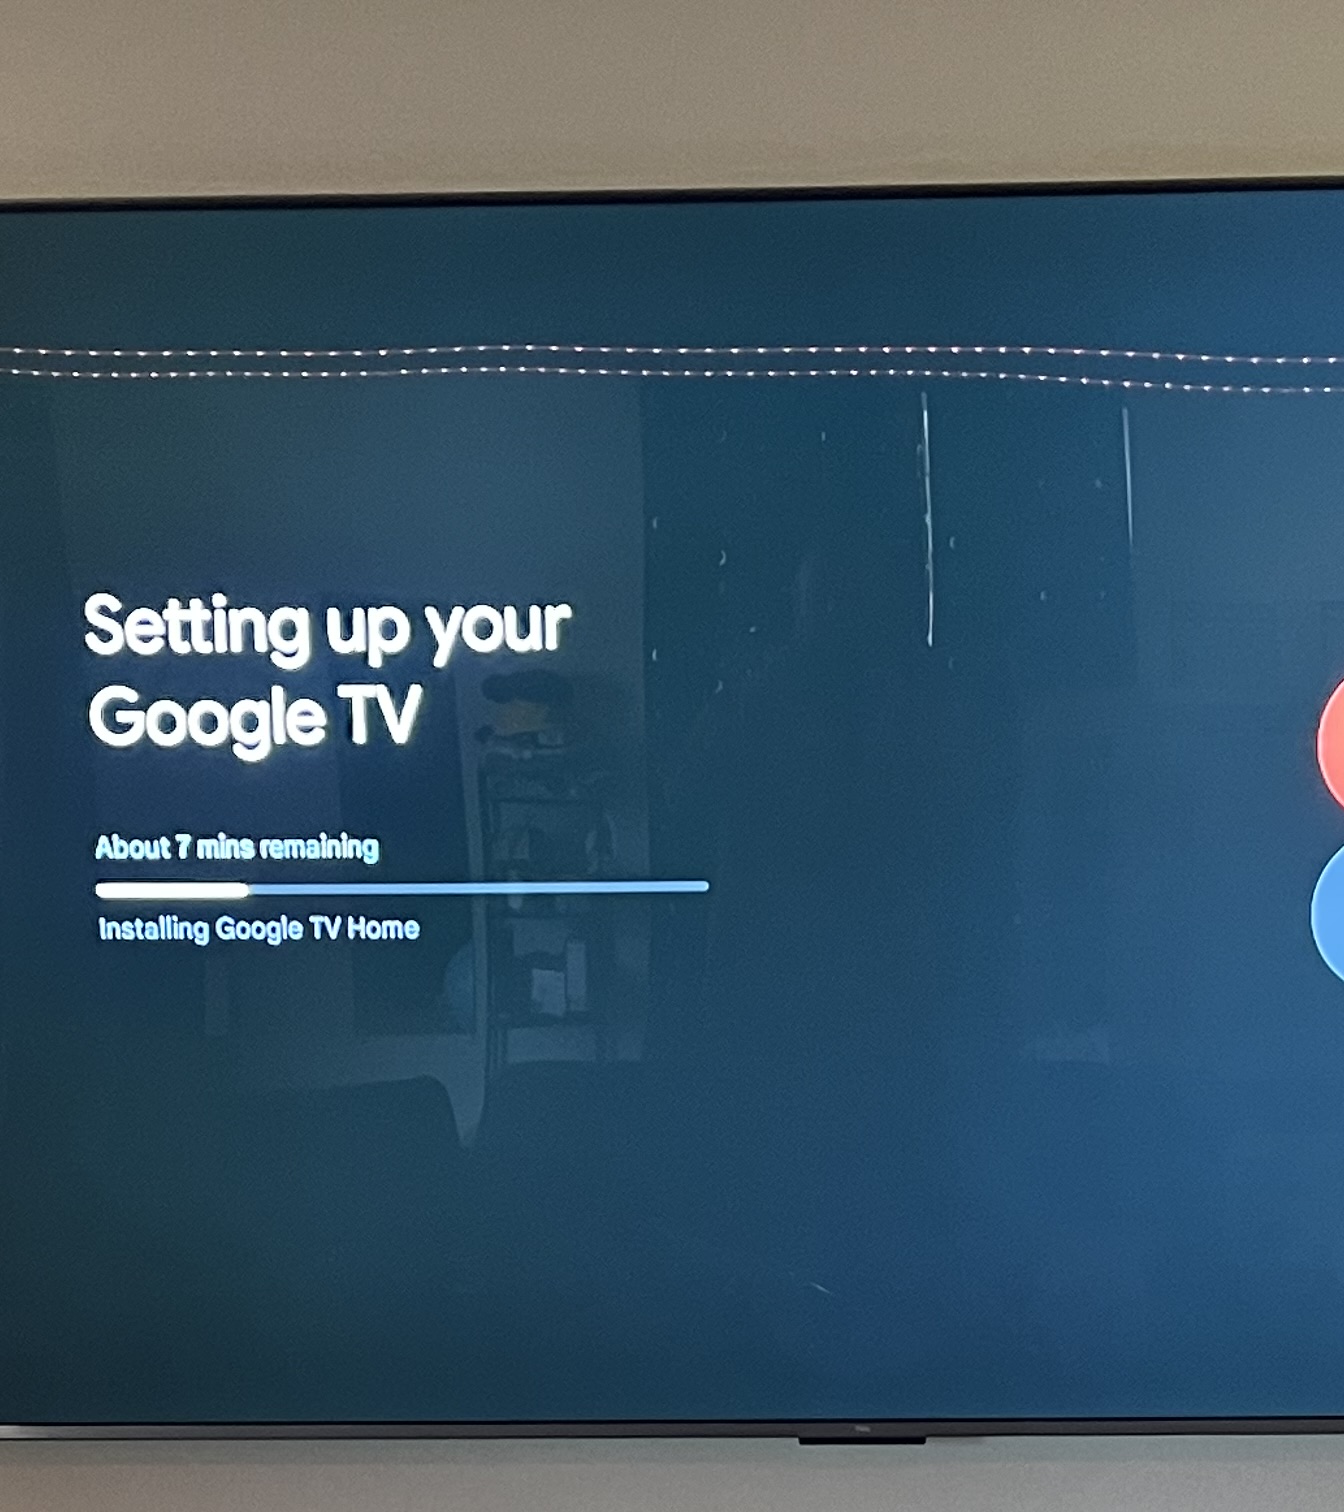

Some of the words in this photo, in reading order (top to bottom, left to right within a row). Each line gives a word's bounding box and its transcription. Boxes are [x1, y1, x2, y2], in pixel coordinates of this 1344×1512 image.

[84, 592, 311, 671] Setting
[326, 606, 412, 669] up
[425, 603, 573, 668] your
[88, 685, 328, 763] Google
[337, 684, 424, 745] TV
[94, 833, 172, 862] About
[176, 834, 193, 860] 7
[196, 831, 256, 861] mins
[259, 831, 381, 866] remaining
[98, 914, 210, 947] Installing
[214, 914, 304, 947] Google
[308, 914, 343, 941] TV
[347, 914, 422, 941] Home
